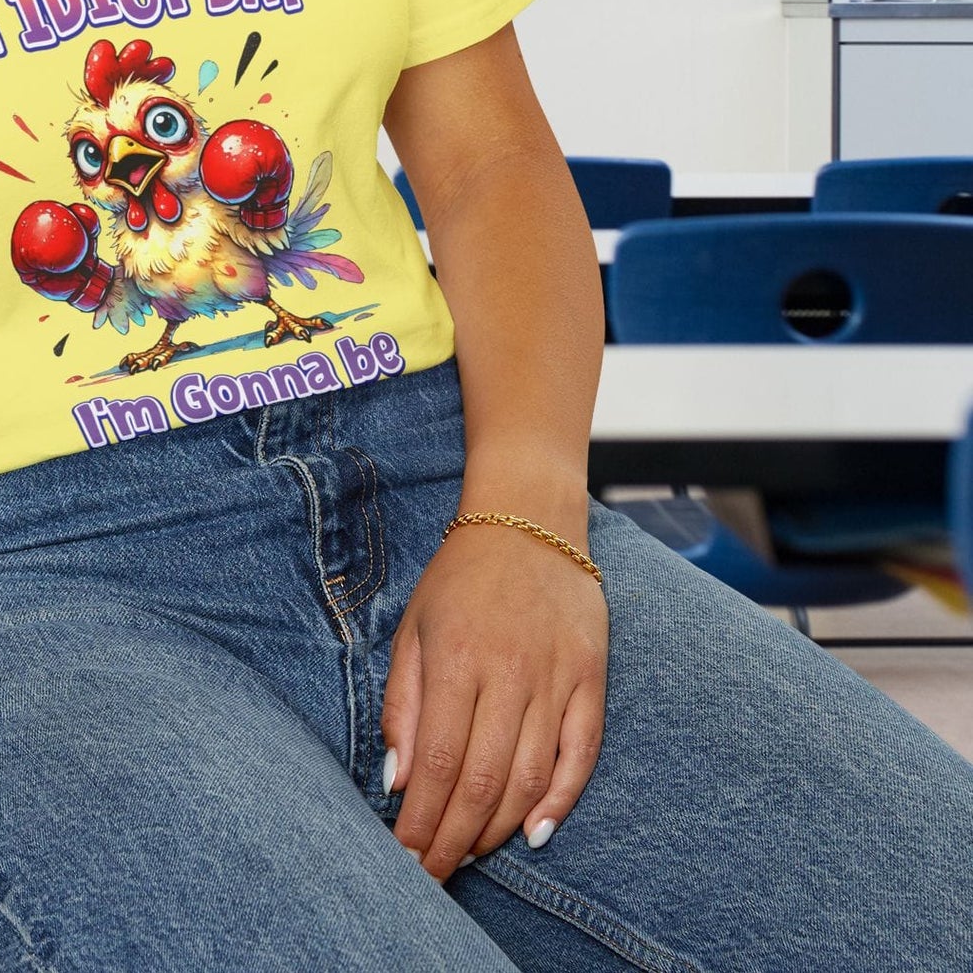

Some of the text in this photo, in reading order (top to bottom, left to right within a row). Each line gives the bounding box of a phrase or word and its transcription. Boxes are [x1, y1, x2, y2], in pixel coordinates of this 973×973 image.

[71, 331, 407, 450] I'm Gonna be
